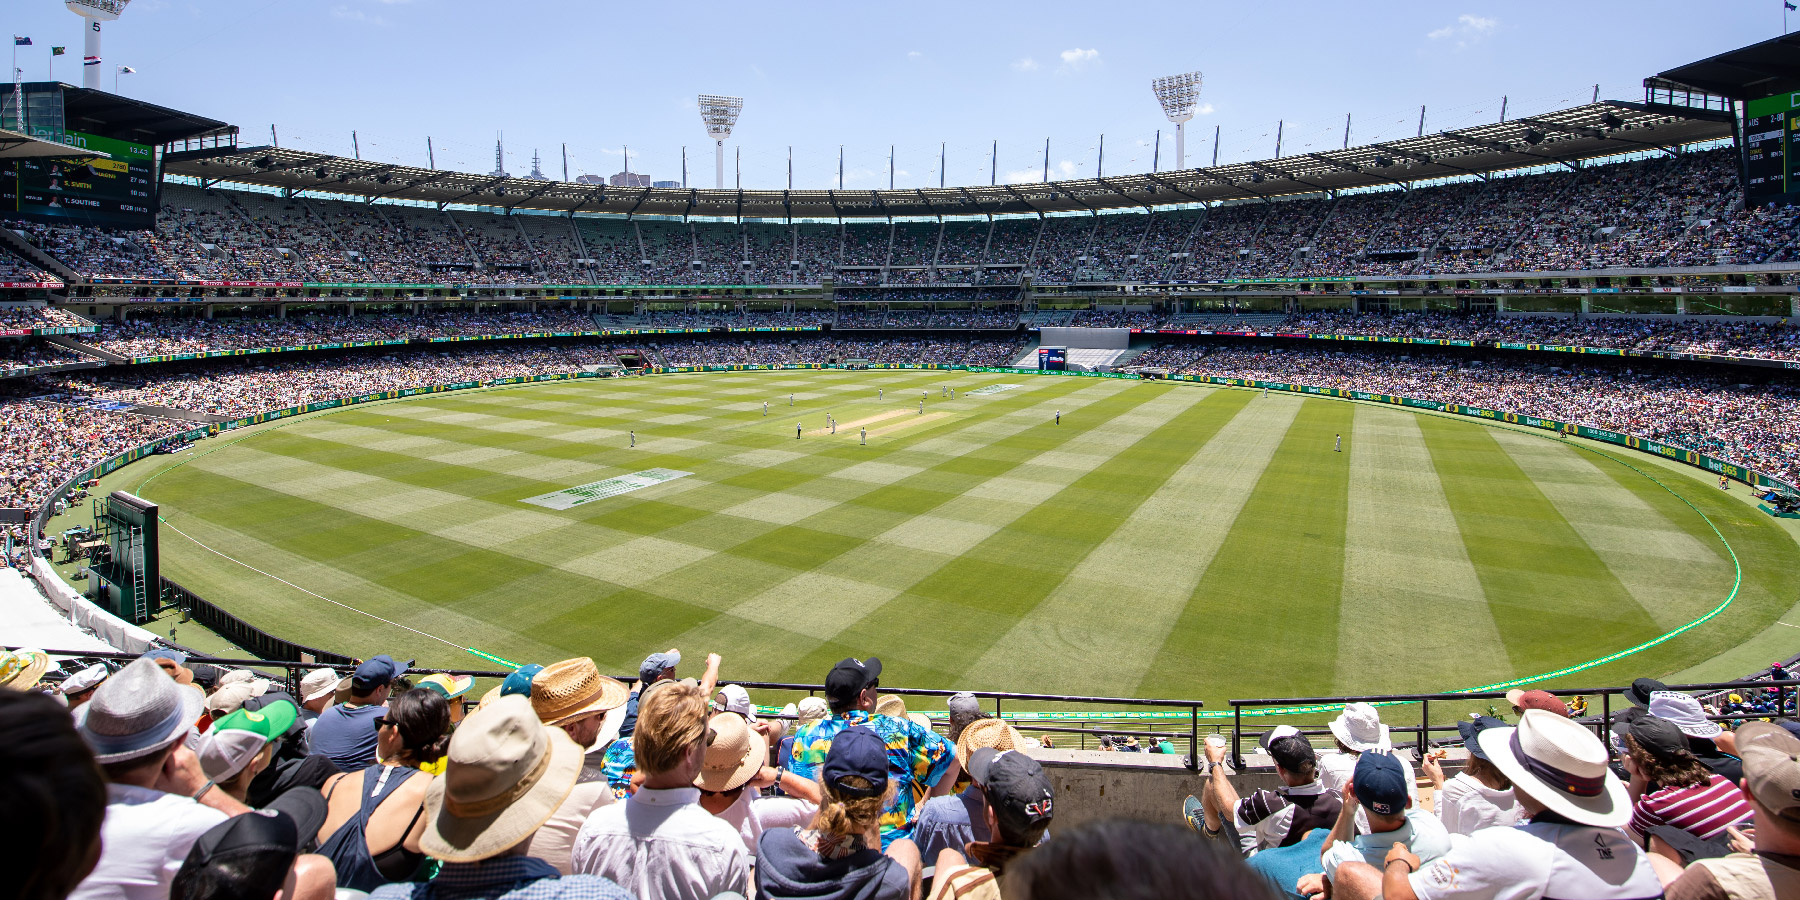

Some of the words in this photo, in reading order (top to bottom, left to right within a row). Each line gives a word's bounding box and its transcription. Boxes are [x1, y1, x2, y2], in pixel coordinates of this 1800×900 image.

[92, 22, 101, 32] 5
[1357, 390, 1382, 400] bet365
[270, 409, 291, 420] bet365
[1466, 407, 1495, 418] bet365
[226, 418, 248, 429] bet365
[1526, 417, 1555, 429] bet365
[1647, 441, 1677, 457] bet365
[106, 456, 124, 472] bet365
[1708, 458, 1738, 476] bet365
